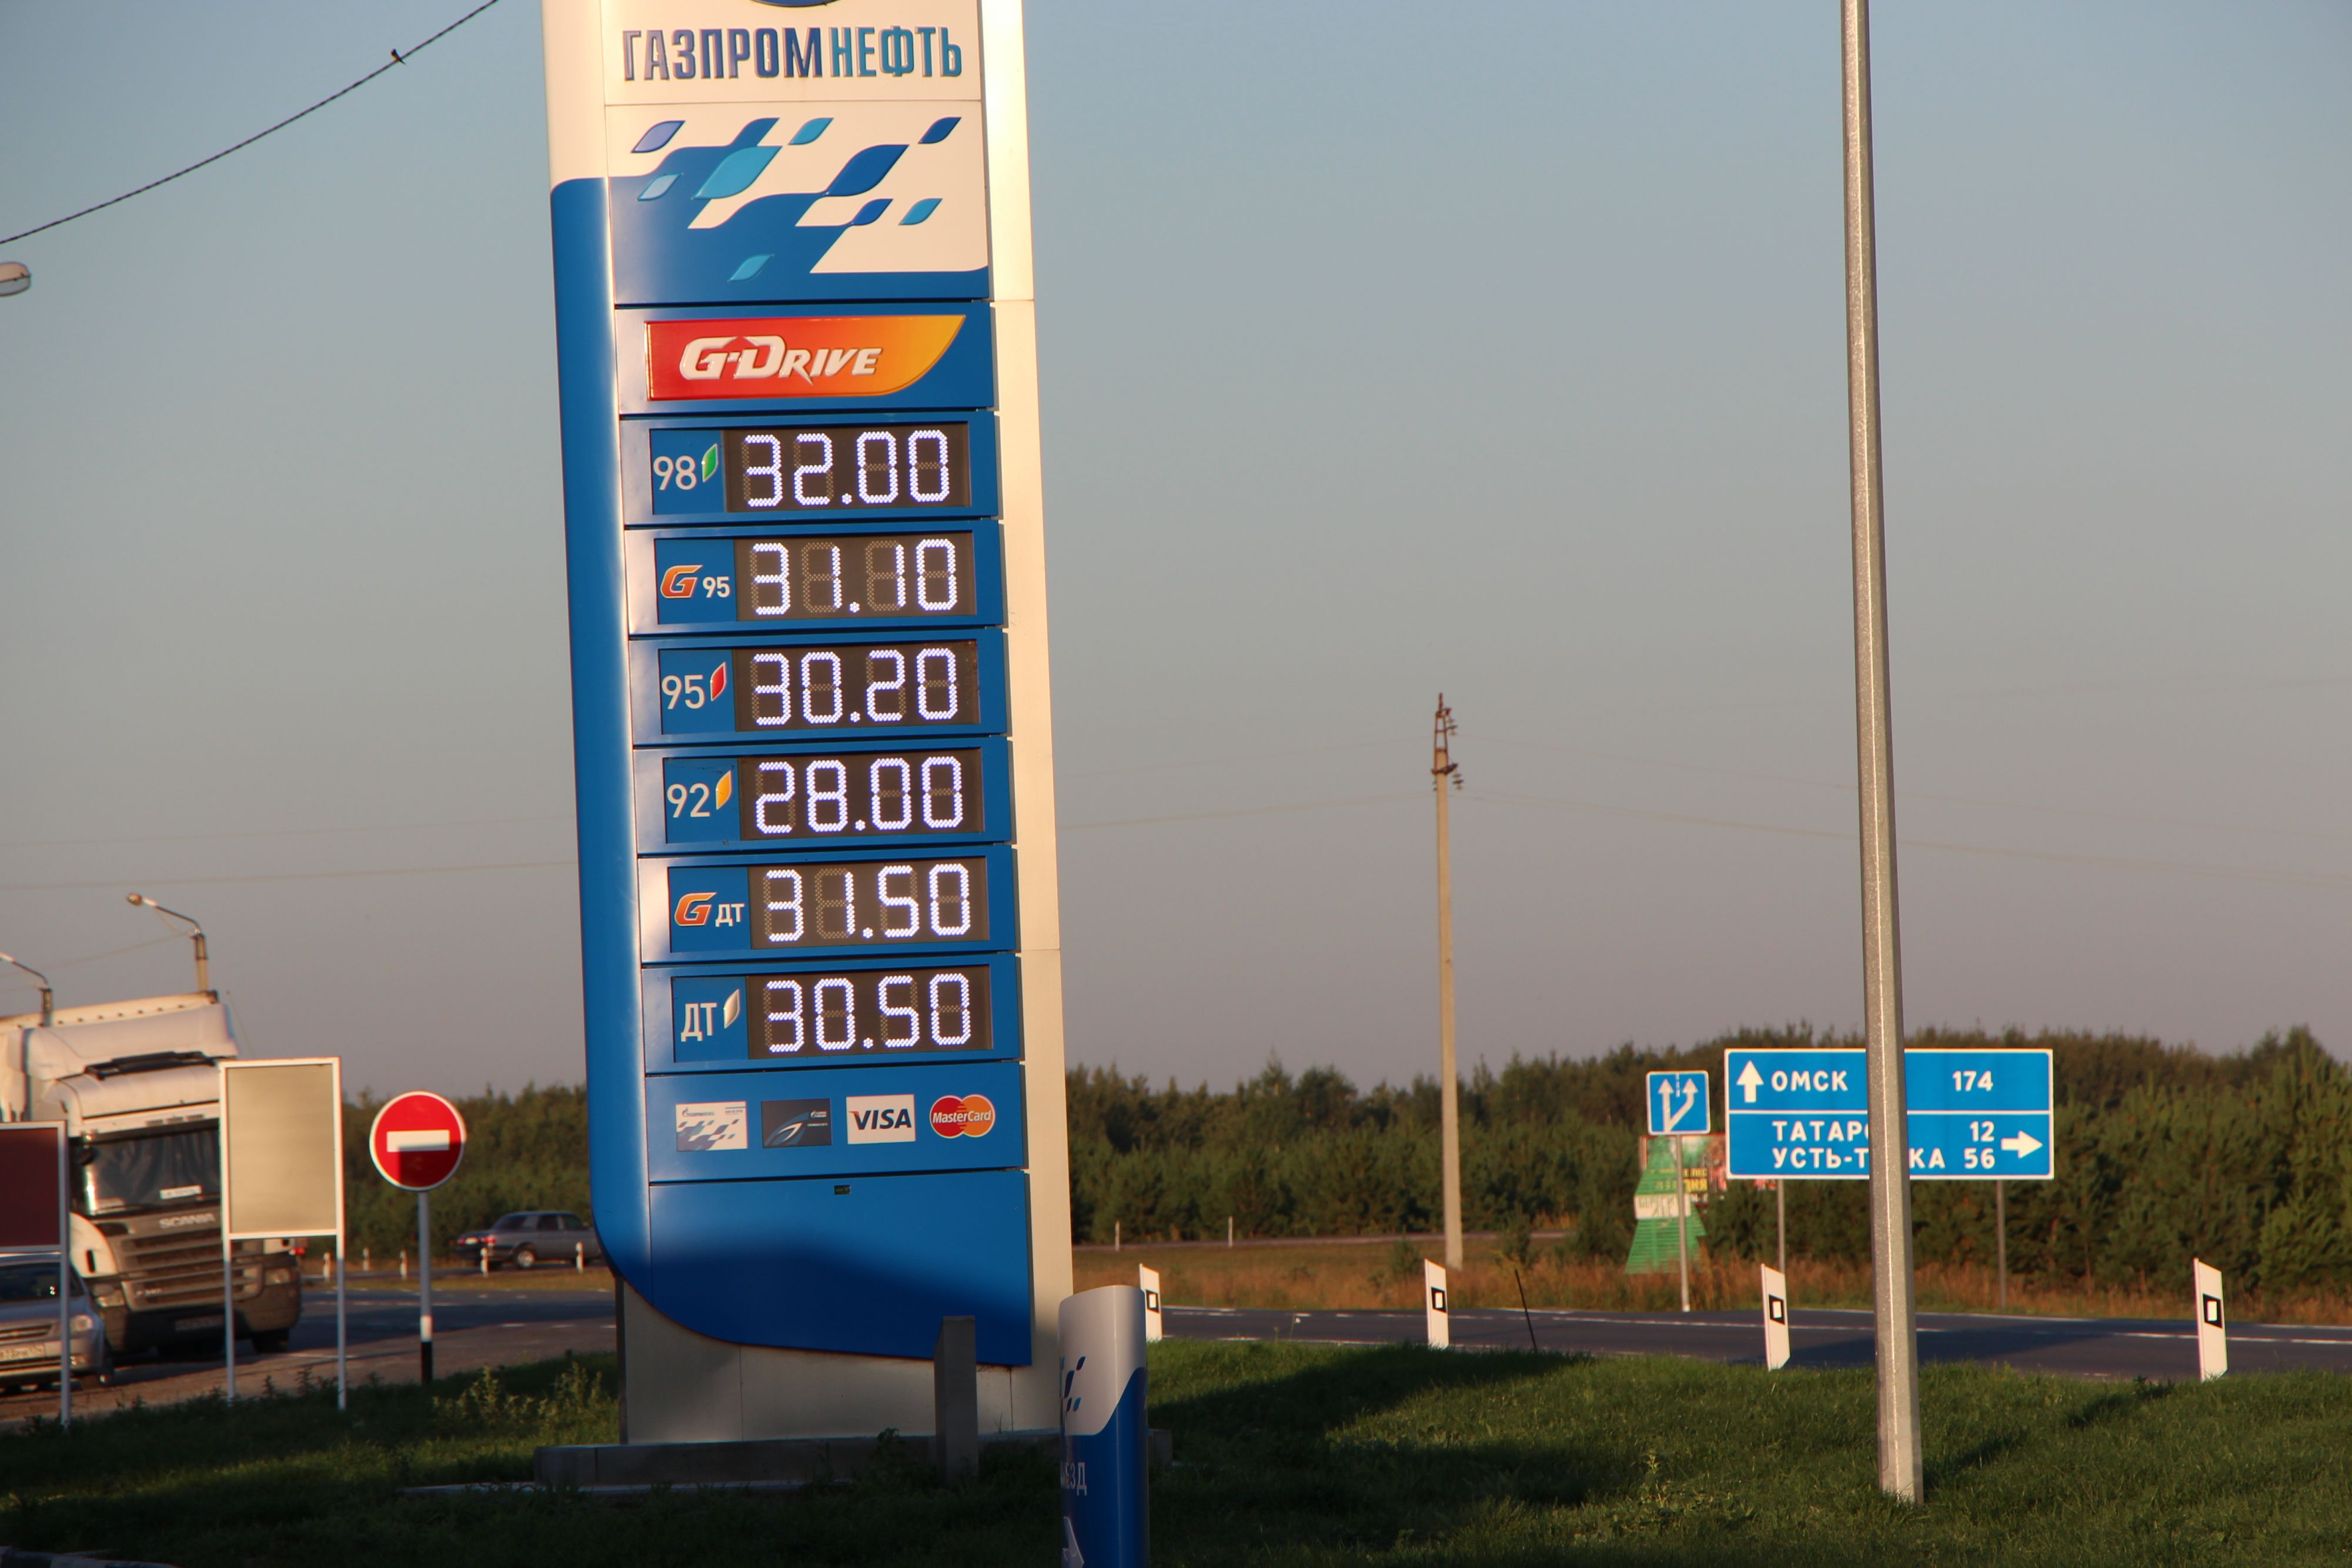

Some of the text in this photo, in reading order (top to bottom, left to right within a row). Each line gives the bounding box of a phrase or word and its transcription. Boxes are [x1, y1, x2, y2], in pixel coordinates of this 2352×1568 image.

[622, 25, 963, 81] ГАЗПРОМНЕФТЬ
[653, 429, 950, 507] 98 32.00
[703, 576, 730, 598] 95
[752, 539, 957, 616] 31.10
[662, 647, 958, 726] 95 30.20
[667, 756, 963, 834] 92 28.00
[715, 902, 745, 927] ДТ
[766, 863, 971, 942] 31.50
[680, 973, 971, 1053] ДТ 30.50
[1770, 1070, 1994, 1092] ОМСК 174
[848, 1108, 912, 1130] VISA
[932, 1110, 991, 1124] MasterCard
[1969, 1120, 1995, 1142] 12
[1772, 1146, 1996, 1169] УСТЬ-ТКА 56
[159, 1213, 216, 1229] SCANIA
